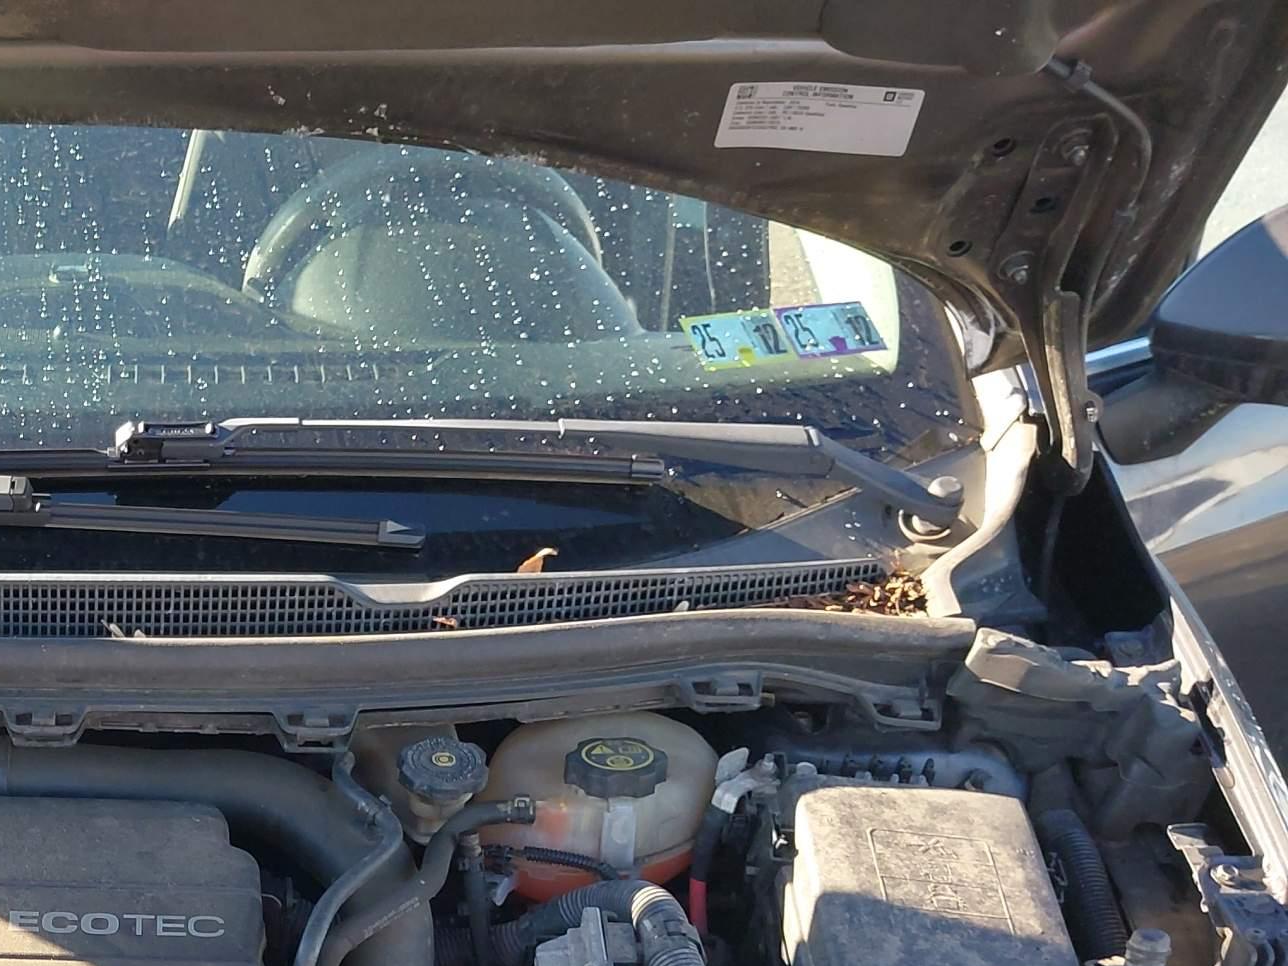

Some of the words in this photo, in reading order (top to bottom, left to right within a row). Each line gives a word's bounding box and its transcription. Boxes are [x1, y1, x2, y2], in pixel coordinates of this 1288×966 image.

[691, 322, 726, 359] 25
[783, 313, 820, 349] 25
[8, 909, 226, 938] ECOTEC
